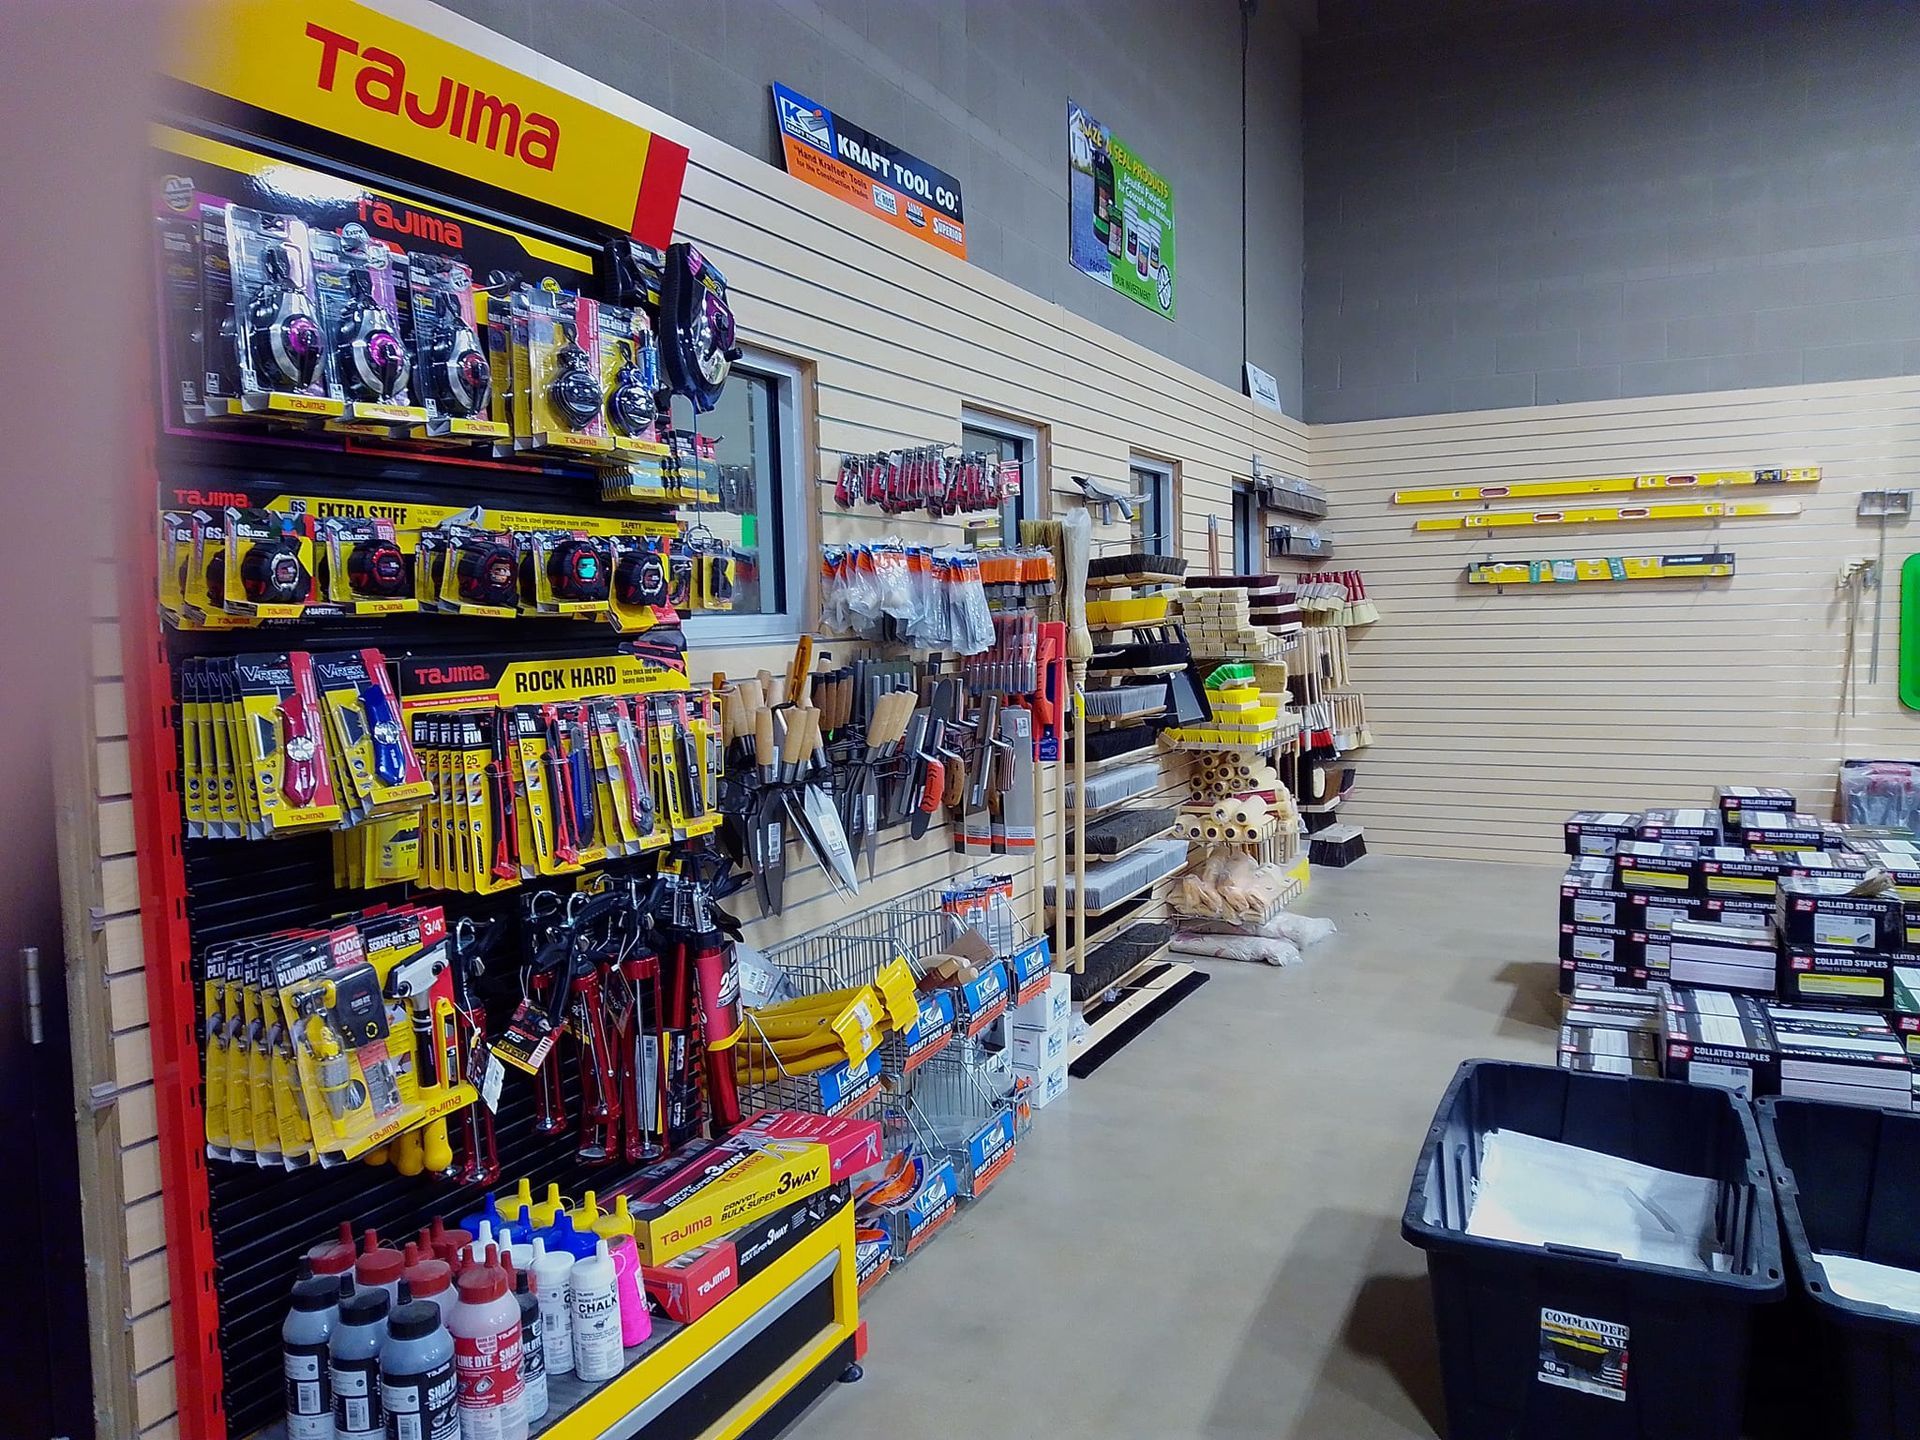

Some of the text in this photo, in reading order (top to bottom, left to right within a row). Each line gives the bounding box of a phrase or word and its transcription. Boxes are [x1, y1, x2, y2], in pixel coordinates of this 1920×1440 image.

[837, 133, 891, 177] KRAFT
[893, 163, 933, 200] TOOL
[1132, 160, 1169, 199] PRODUCTS
[290, 500, 407, 525] GS EXTRA STIFF
[500, 514, 514, 522] Extra
[620, 521, 642, 529] SAFETY
[515, 666, 617, 693] ROCK HARD
[518, 720, 536, 732] FIN
[463, 729, 482, 744] FIN
[523, 742, 534, 752] 25
[467, 755, 478, 765] 25
[1764, 831, 1820, 840] COLLATED STAPLES
[1722, 863, 1779, 873] COLLATED STAPLES
[1810, 870, 1841, 878] COLLATED
[1724, 900, 1754, 909] COLLATED
[1817, 900, 1854, 910] COLLATED
[1855, 902, 1888, 912] STAPLES
[1815, 957, 1853, 967] COLLATED
[1854, 959, 1888, 969] STAPLES
[277, 956, 329, 988] PLUMB-RITE
[909, 1040, 928, 1055] KRAFT
[928, 1030, 942, 1046] TOOL
[1694, 1046, 1734, 1059] COLLATED
[1735, 1050, 1770, 1062] STAPLES
[826, 1095, 849, 1117] KRAFT
[851, 1084, 868, 1102] TOOL
[721, 1204, 745, 1221] BULK
[745, 1190, 776, 1209] SUPER
[722, 1190, 759, 1212] CONVOY
[862, 1260, 878, 1281] TOOL
[578, 1296, 618, 1313] CHALK
[1545, 1311, 1627, 1337] COMMANDER
[1603, 1336, 1627, 1349] XXL
[500, 1342, 520, 1361] SNAP
[457, 1354, 493, 1368] LINE DYE
[1543, 1360, 1556, 1372] 40
[428, 1382, 452, 1401] SNAP
